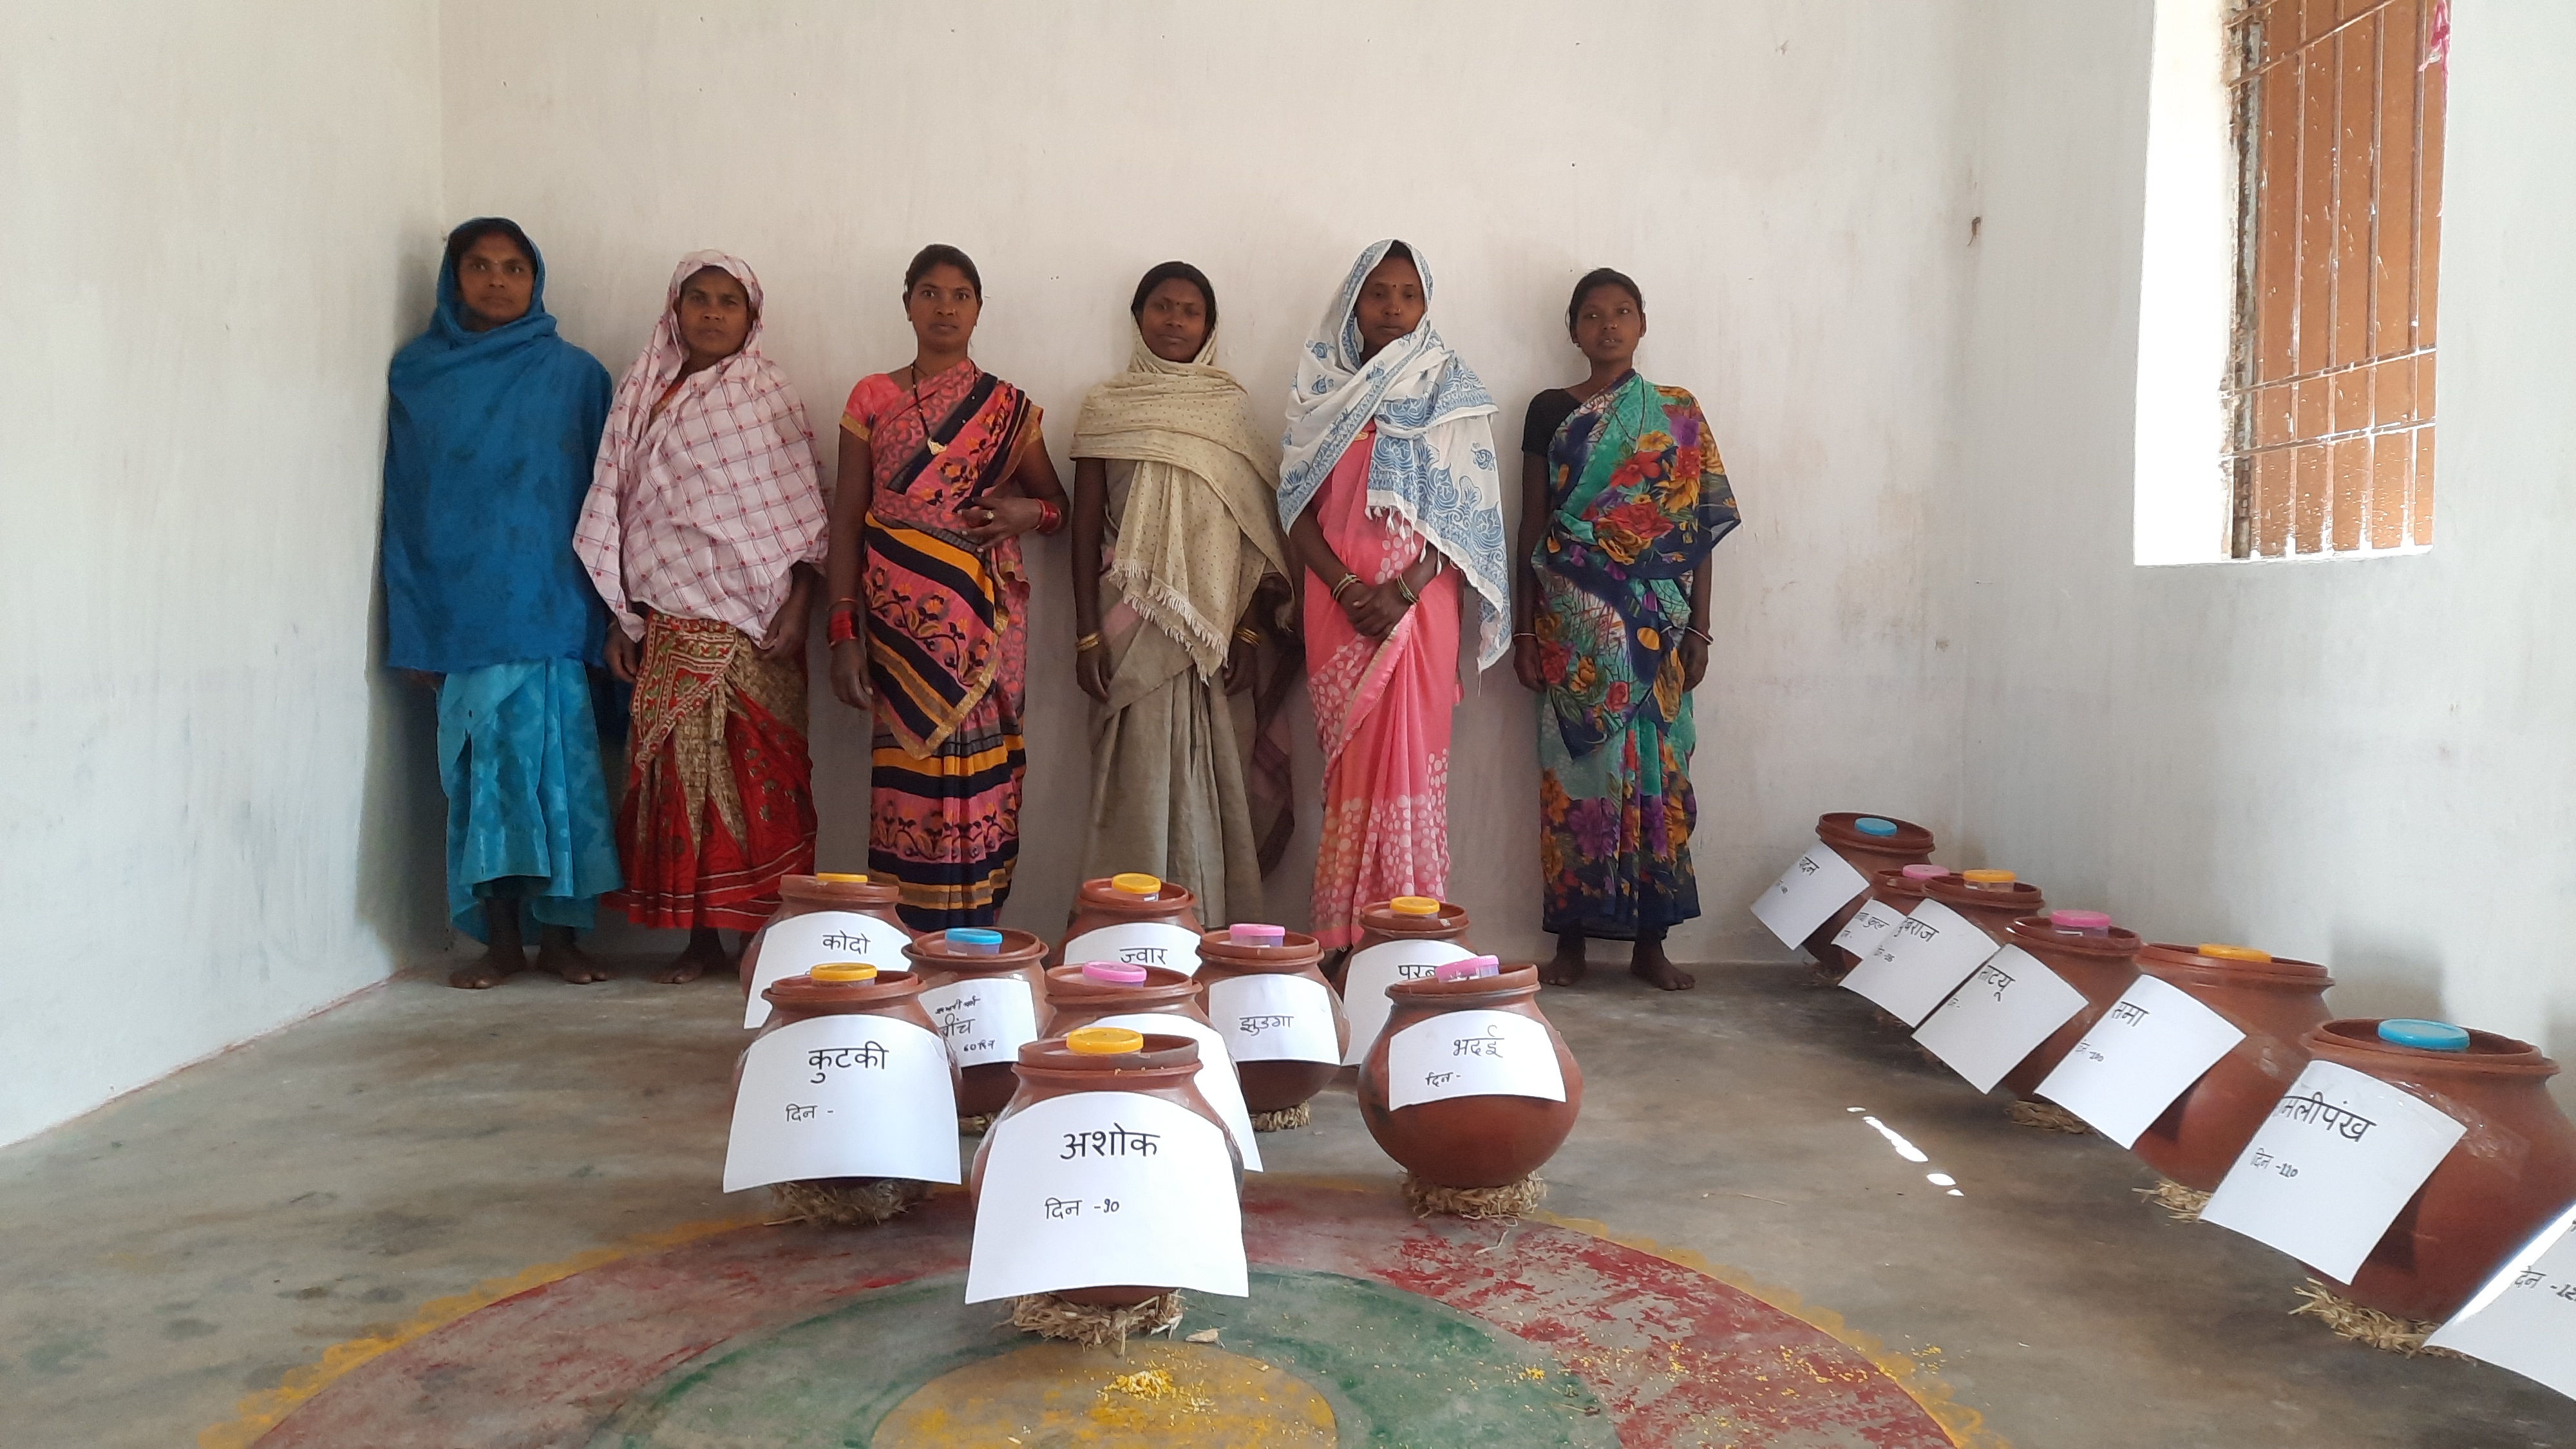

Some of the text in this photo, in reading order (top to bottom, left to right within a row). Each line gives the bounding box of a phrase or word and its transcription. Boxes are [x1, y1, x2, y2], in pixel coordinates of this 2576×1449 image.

[822, 930, 871, 954] कोदो
[1119, 948, 1168, 965] ज्वार
[1453, 1025, 1505, 1058] भदई
[808, 1041, 889, 1083] कुटकी
[786, 1104, 818, 1122] दिन
[1059, 1122, 1160, 1159] अशोक
[1045, 1197, 1083, 1219] दिन
